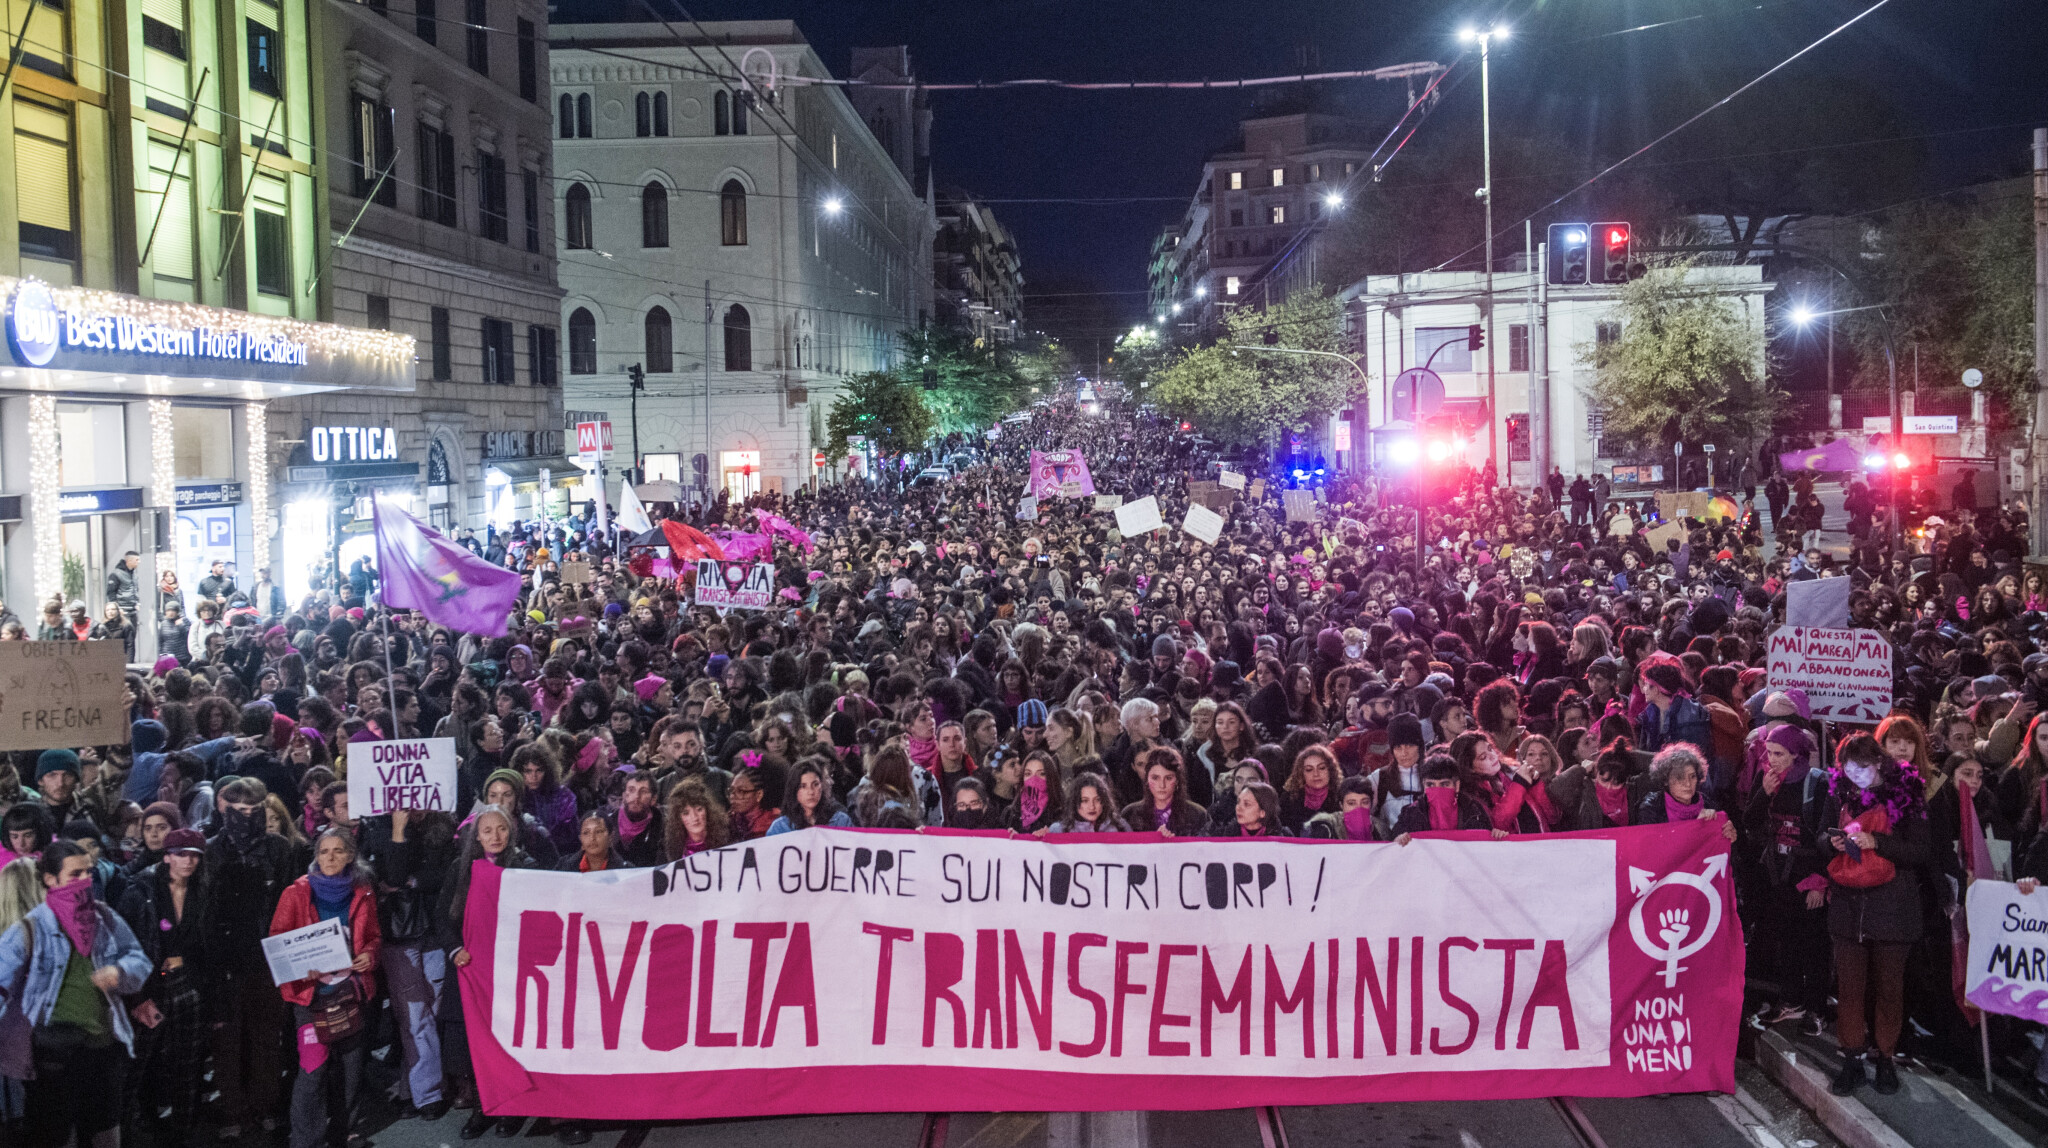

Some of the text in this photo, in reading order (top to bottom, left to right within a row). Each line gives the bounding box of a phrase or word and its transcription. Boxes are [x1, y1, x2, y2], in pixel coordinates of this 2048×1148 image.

[67, 311, 308, 366] Best Western Hotel President
[312, 426, 397, 461] OTTICA
[486, 430, 558, 457] SNACK BAR
[580, 427, 596, 448] M
[1051, 454, 1071, 462] BODY
[211, 521, 229, 543] P
[1810, 629, 1853, 640] QUESTA
[21, 642, 88, 658] OBIETTA
[1807, 643, 1852, 659] MAREA
[1855, 642, 1888, 660] MAI
[1772, 661, 1792, 674] MI
[1816, 681, 1836, 689] NON
[22, 707, 103, 731] FREGNA
[372, 742, 431, 764] DONNA
[376, 762, 428, 786] VITA
[369, 782, 443, 814] LIBERTÀ
[652, 846, 762, 897] BASTA
[778, 845, 917, 897] GUERRE
[941, 853, 1002, 904] SUI
[1023, 858, 1160, 911] NOSTRI
[1987, 943, 2048, 982] MAR
[512, 910, 1580, 1059] RIVOLTA TRANSFEMMINISTA
[1635, 993, 1684, 1022] NON
[1623, 1017, 1692, 1047] UNA DI
[1626, 1044, 1692, 1074] MENO
